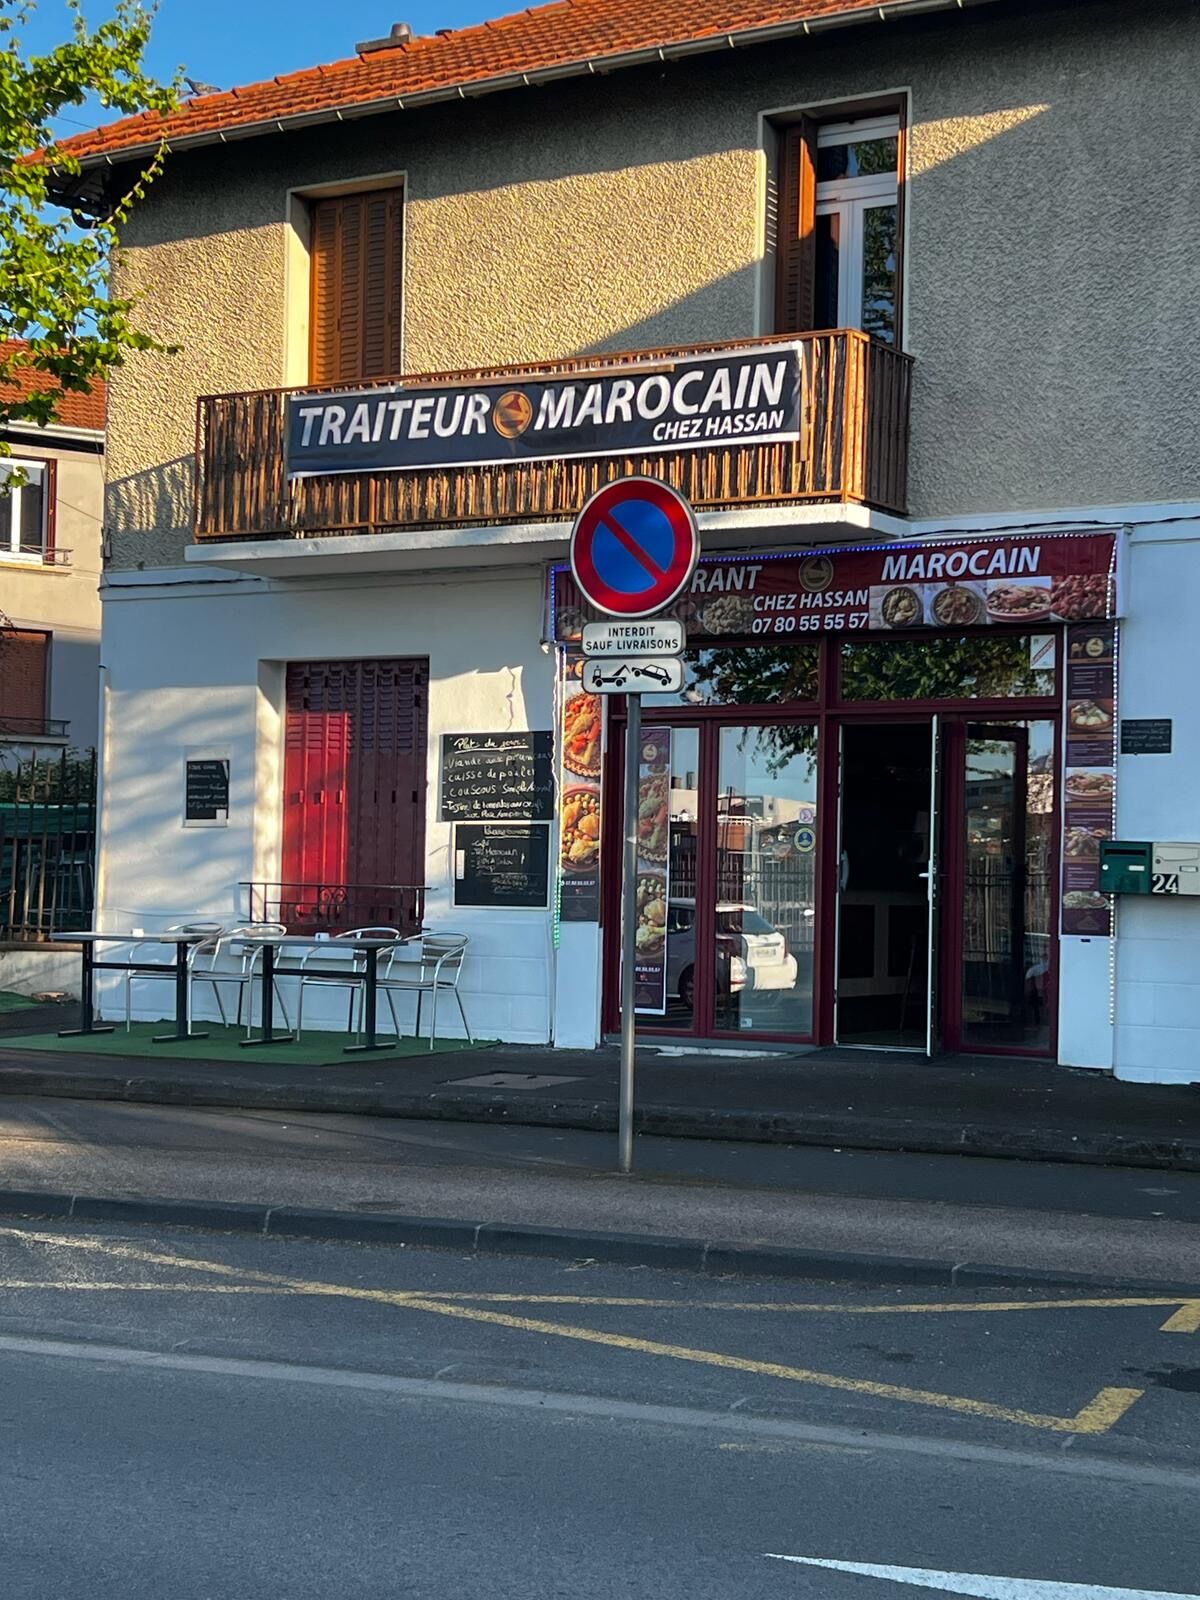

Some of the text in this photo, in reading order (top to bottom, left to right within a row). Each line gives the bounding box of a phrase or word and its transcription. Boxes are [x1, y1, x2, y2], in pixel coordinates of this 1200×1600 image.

[298, 361, 787, 447] TRAITEUR MAROCAIN
[653, 410, 785, 441] CHEZ HASSAN
[880, 546, 1041, 581] MAROCAIN
[753, 589, 869, 611] CHEZ HASSAN
[608, 627, 655, 637] INTERDIT
[752, 612, 869, 633] 07 80 55 55 57
[586, 639, 679, 651] SAUF LIVRAISONS
[1152, 874, 1178, 893] 24
